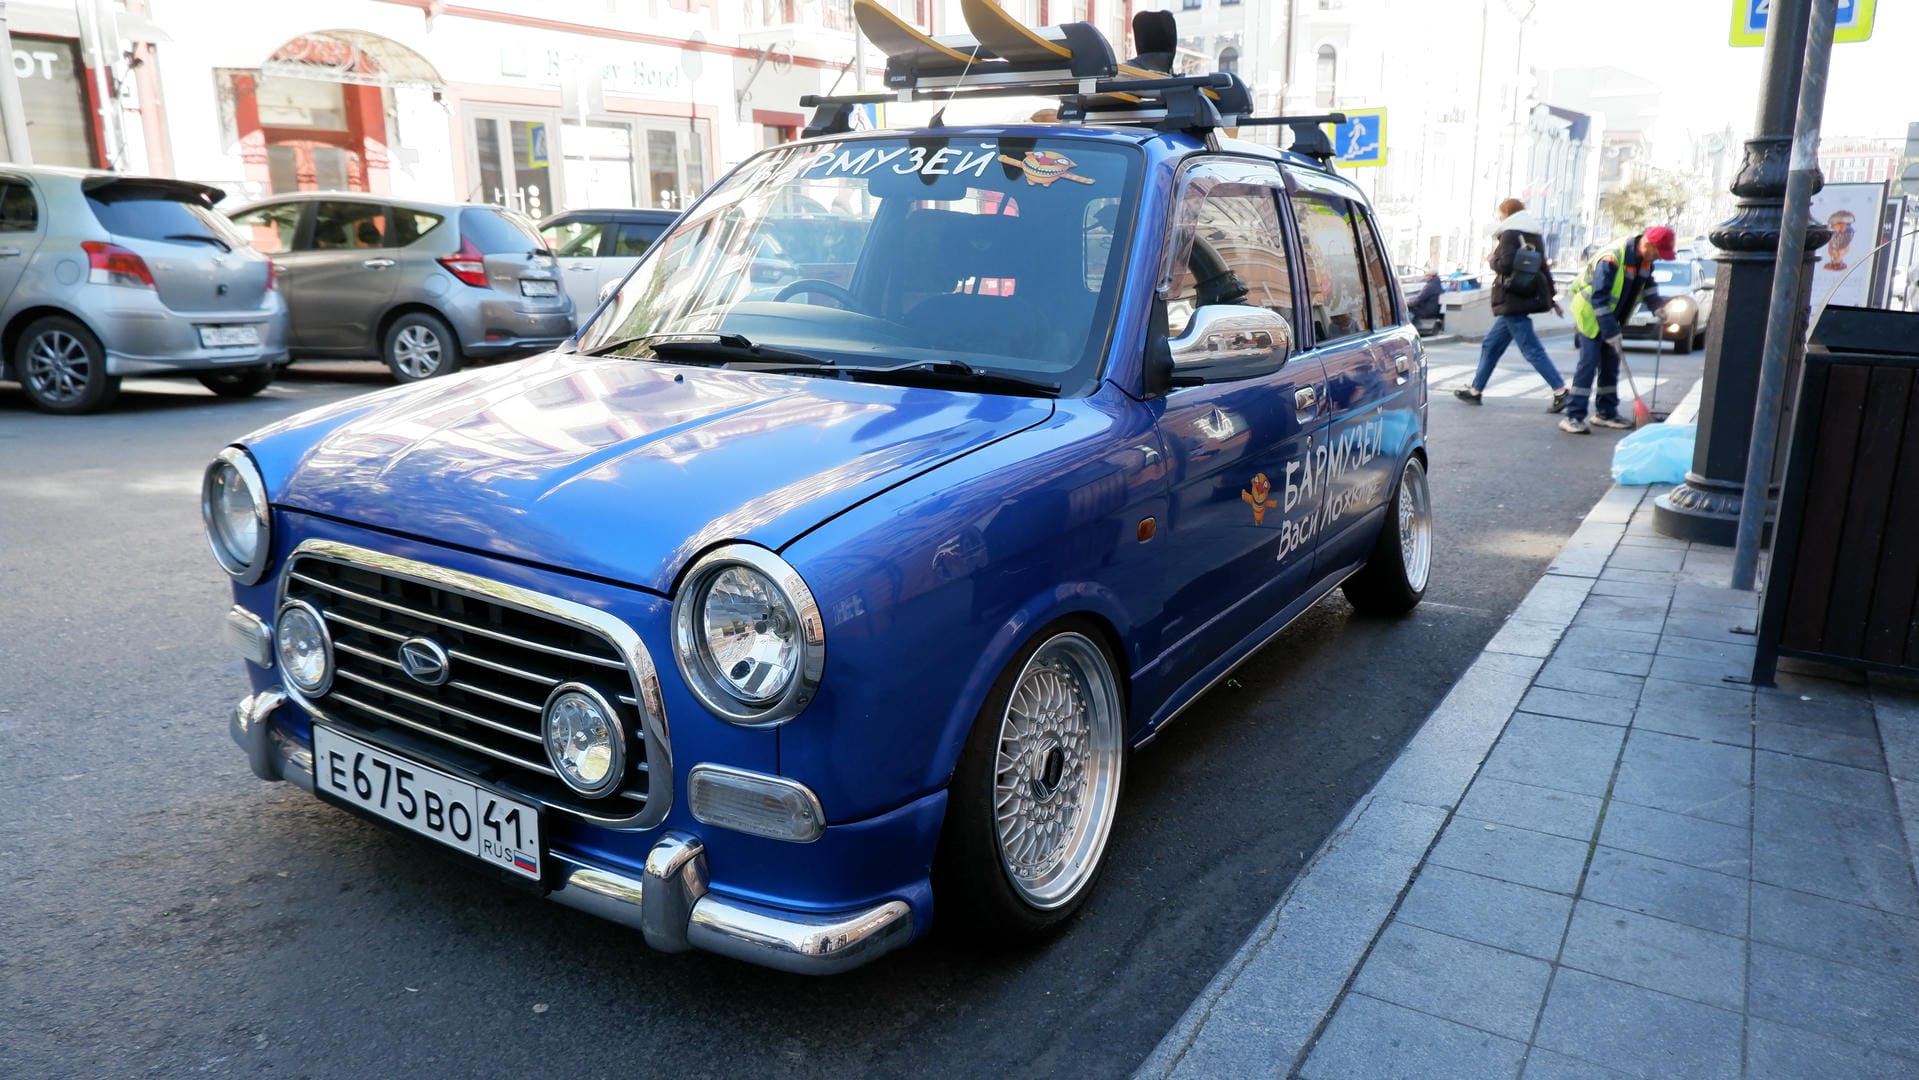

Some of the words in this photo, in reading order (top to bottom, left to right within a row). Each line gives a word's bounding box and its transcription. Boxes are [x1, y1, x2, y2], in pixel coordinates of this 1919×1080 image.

[1284, 406, 1384, 513] БАРМУЗЕЙ
[1277, 508, 1321, 561] Васи
[1319, 479, 1380, 532] Ложк
[483, 799, 522, 850] 41
[483, 838, 513, 863] RUS
